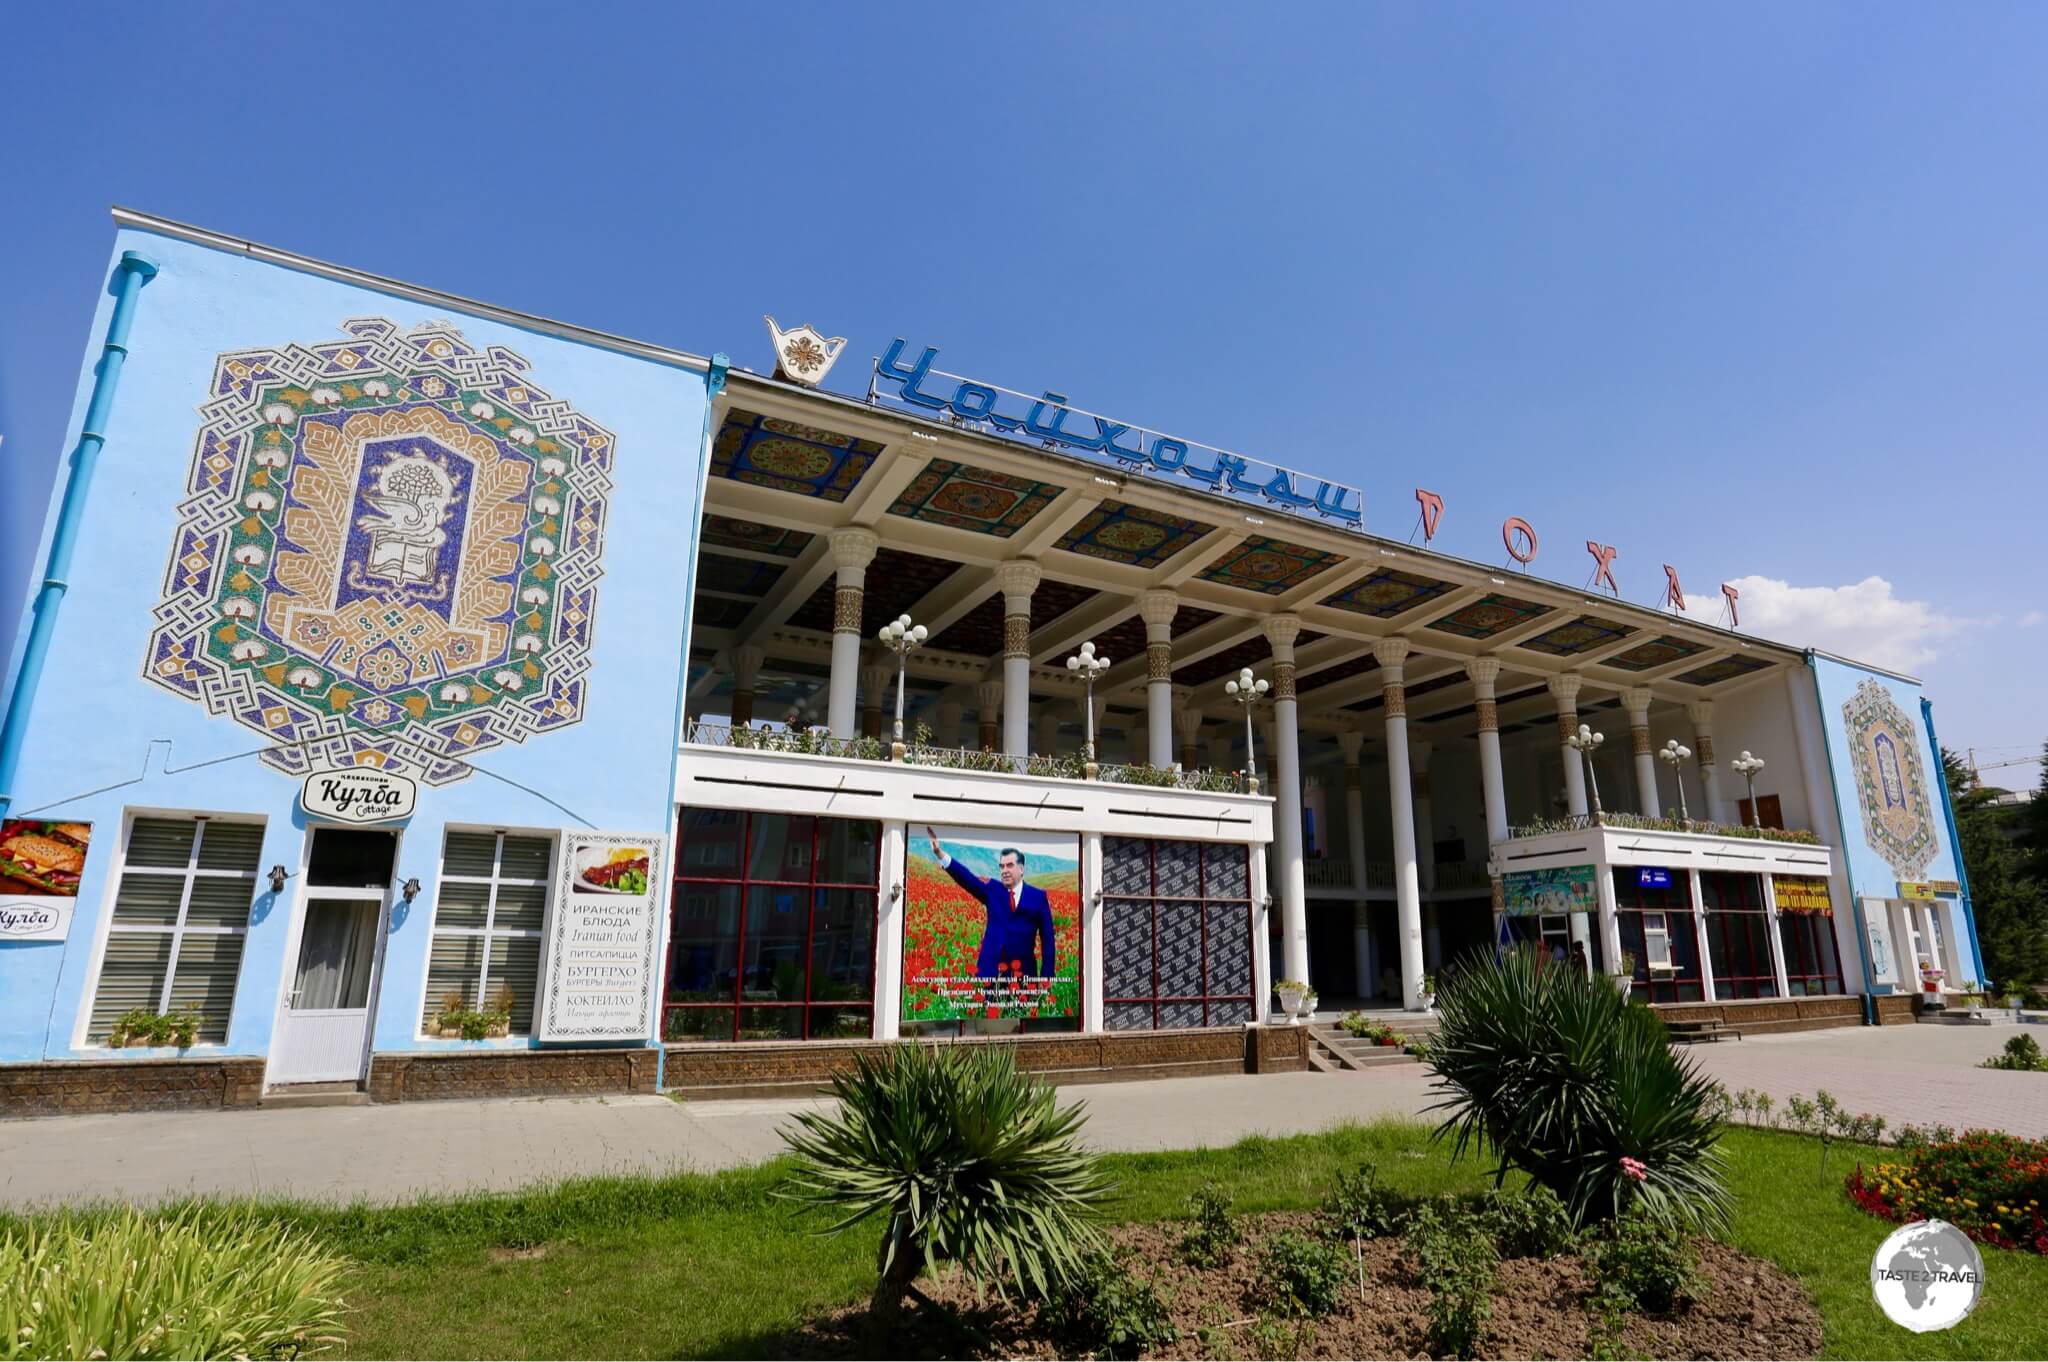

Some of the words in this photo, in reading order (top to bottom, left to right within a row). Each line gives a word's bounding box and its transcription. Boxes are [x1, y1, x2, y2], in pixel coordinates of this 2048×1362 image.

[1415, 487, 1739, 626] РОХАТ
[321, 779, 402, 812] Кулба
[356, 804, 391, 817] Cottage
[573, 904, 642, 915] ИРАНСКИЕ
[582, 917, 631, 927] БЛЮДА
[571, 929, 613, 942] Iranian
[614, 928, 641, 945] food
